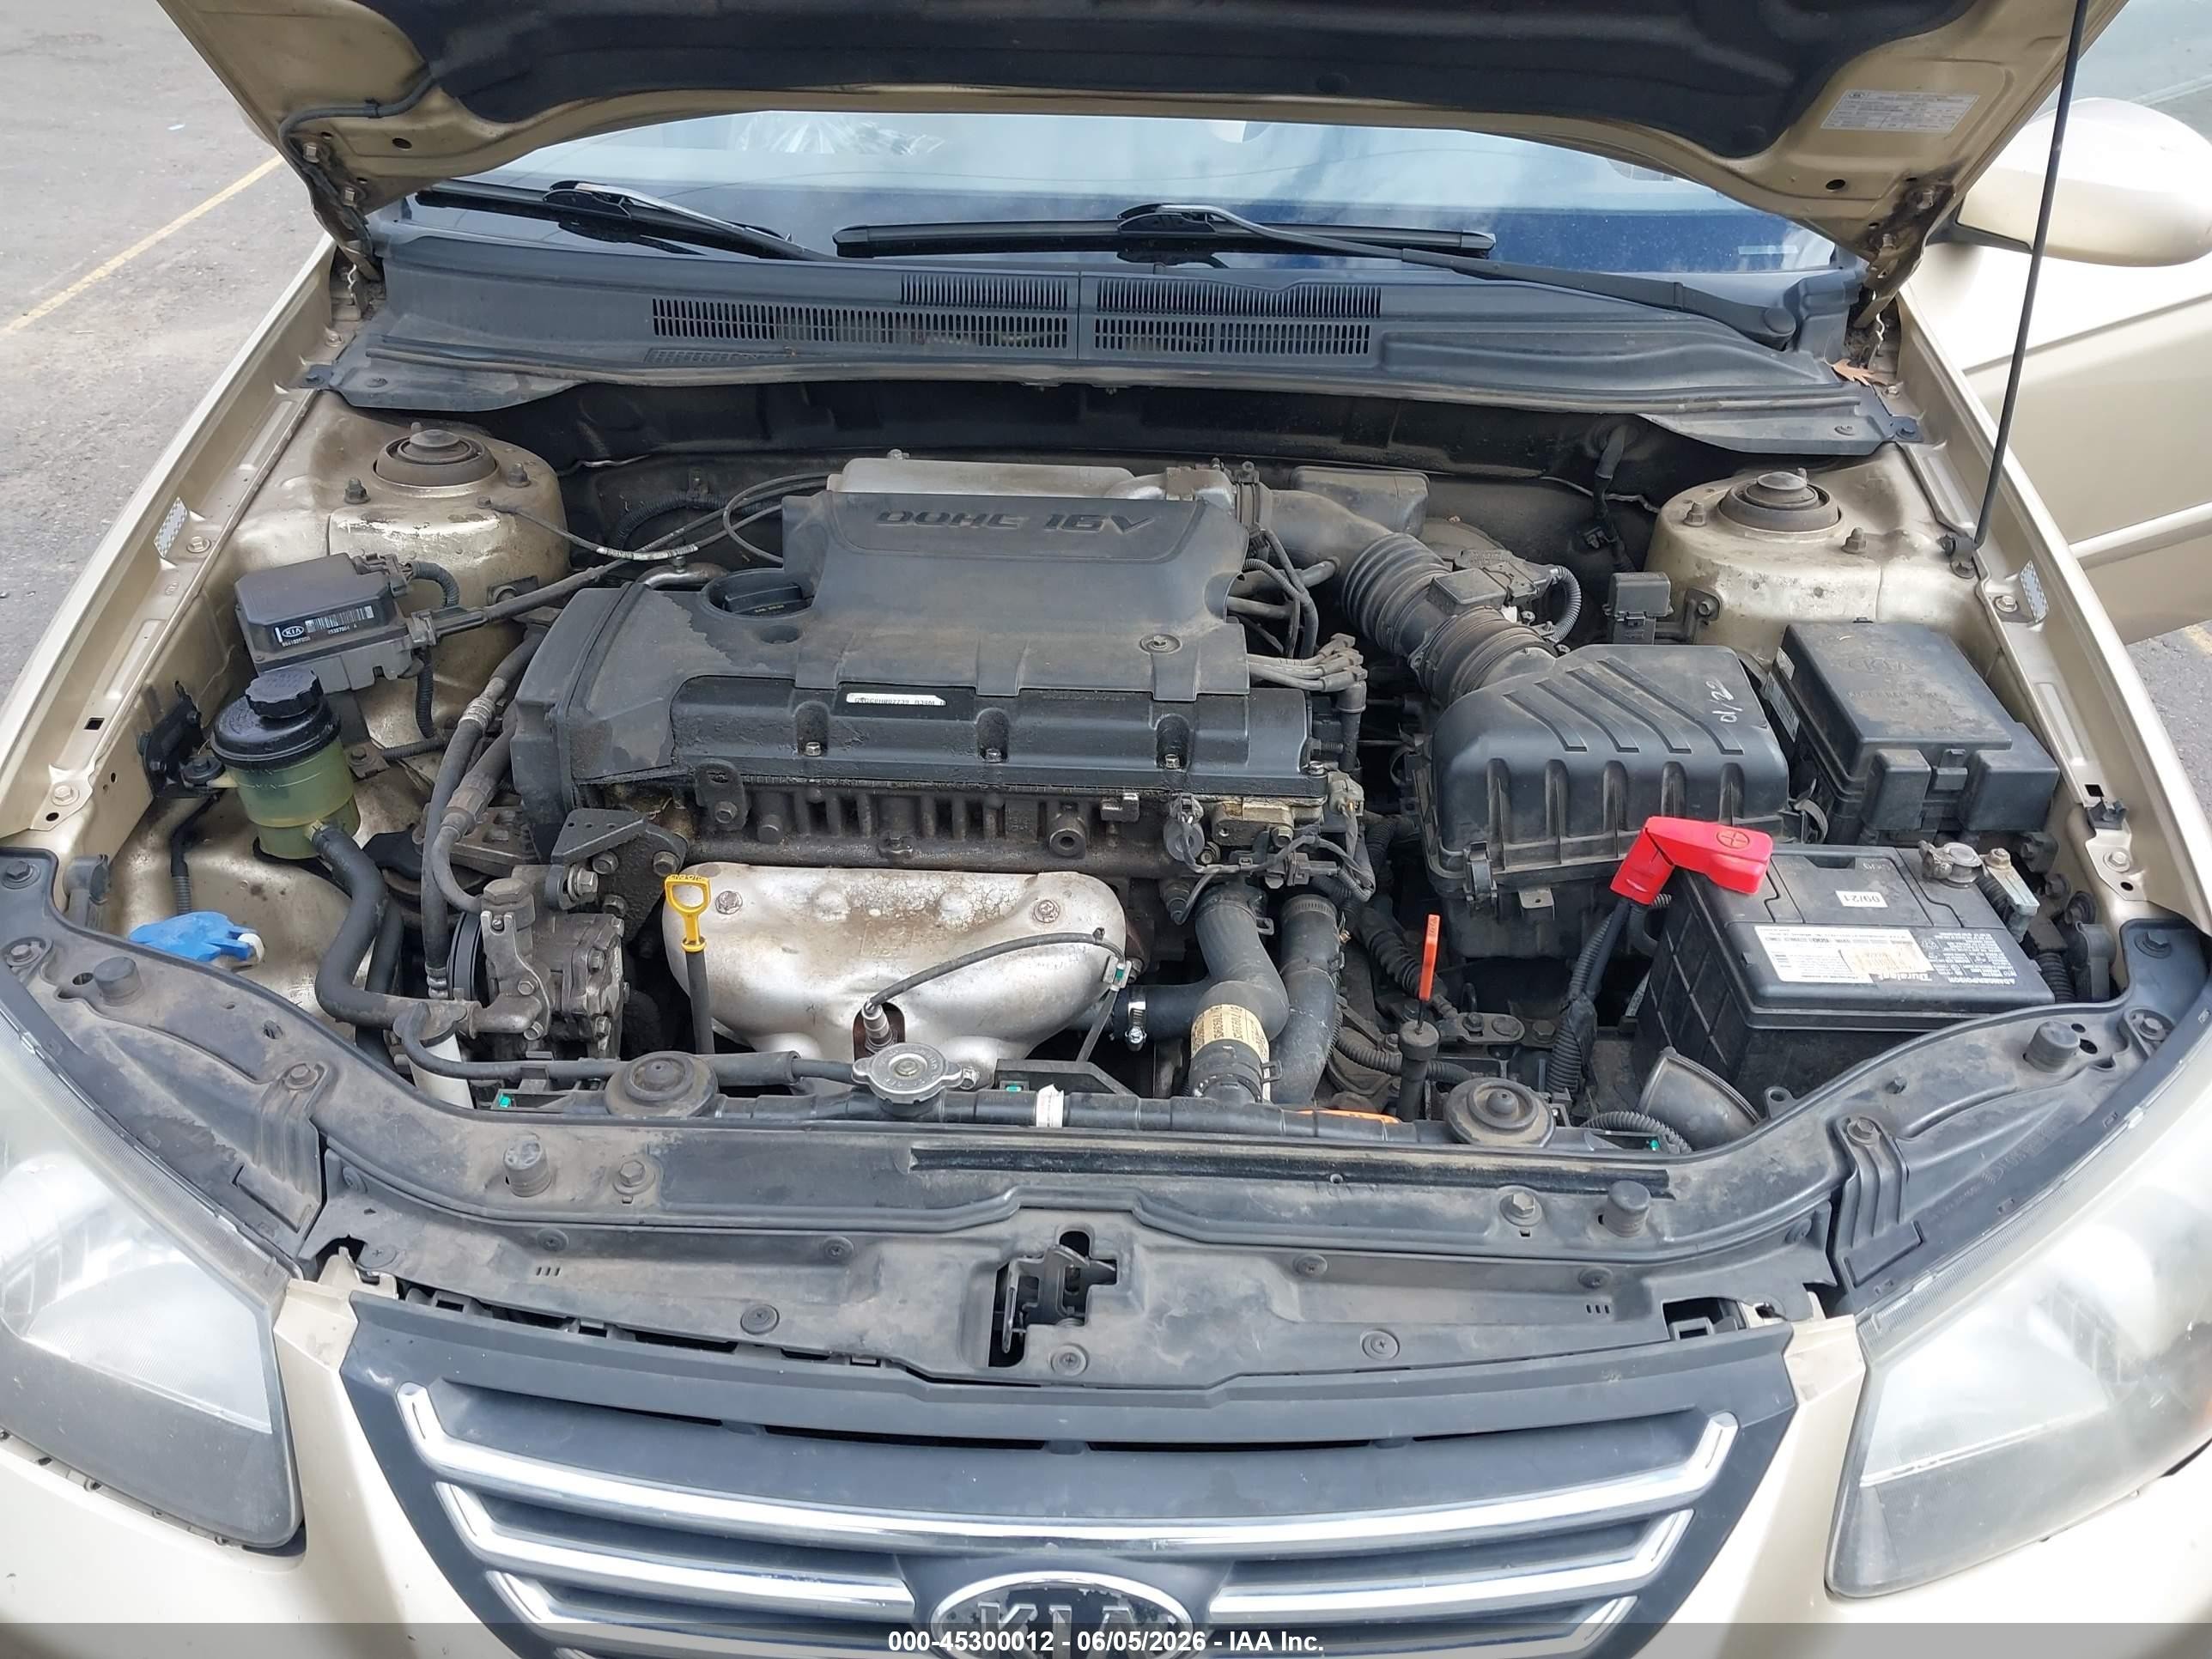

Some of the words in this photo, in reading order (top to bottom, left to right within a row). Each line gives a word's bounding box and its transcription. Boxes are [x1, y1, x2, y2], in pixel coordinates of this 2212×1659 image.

[876, 511, 1030, 530] DOHC
[1042, 513, 1156, 534] 16V
[1844, 893, 1881, 903] 09/21
